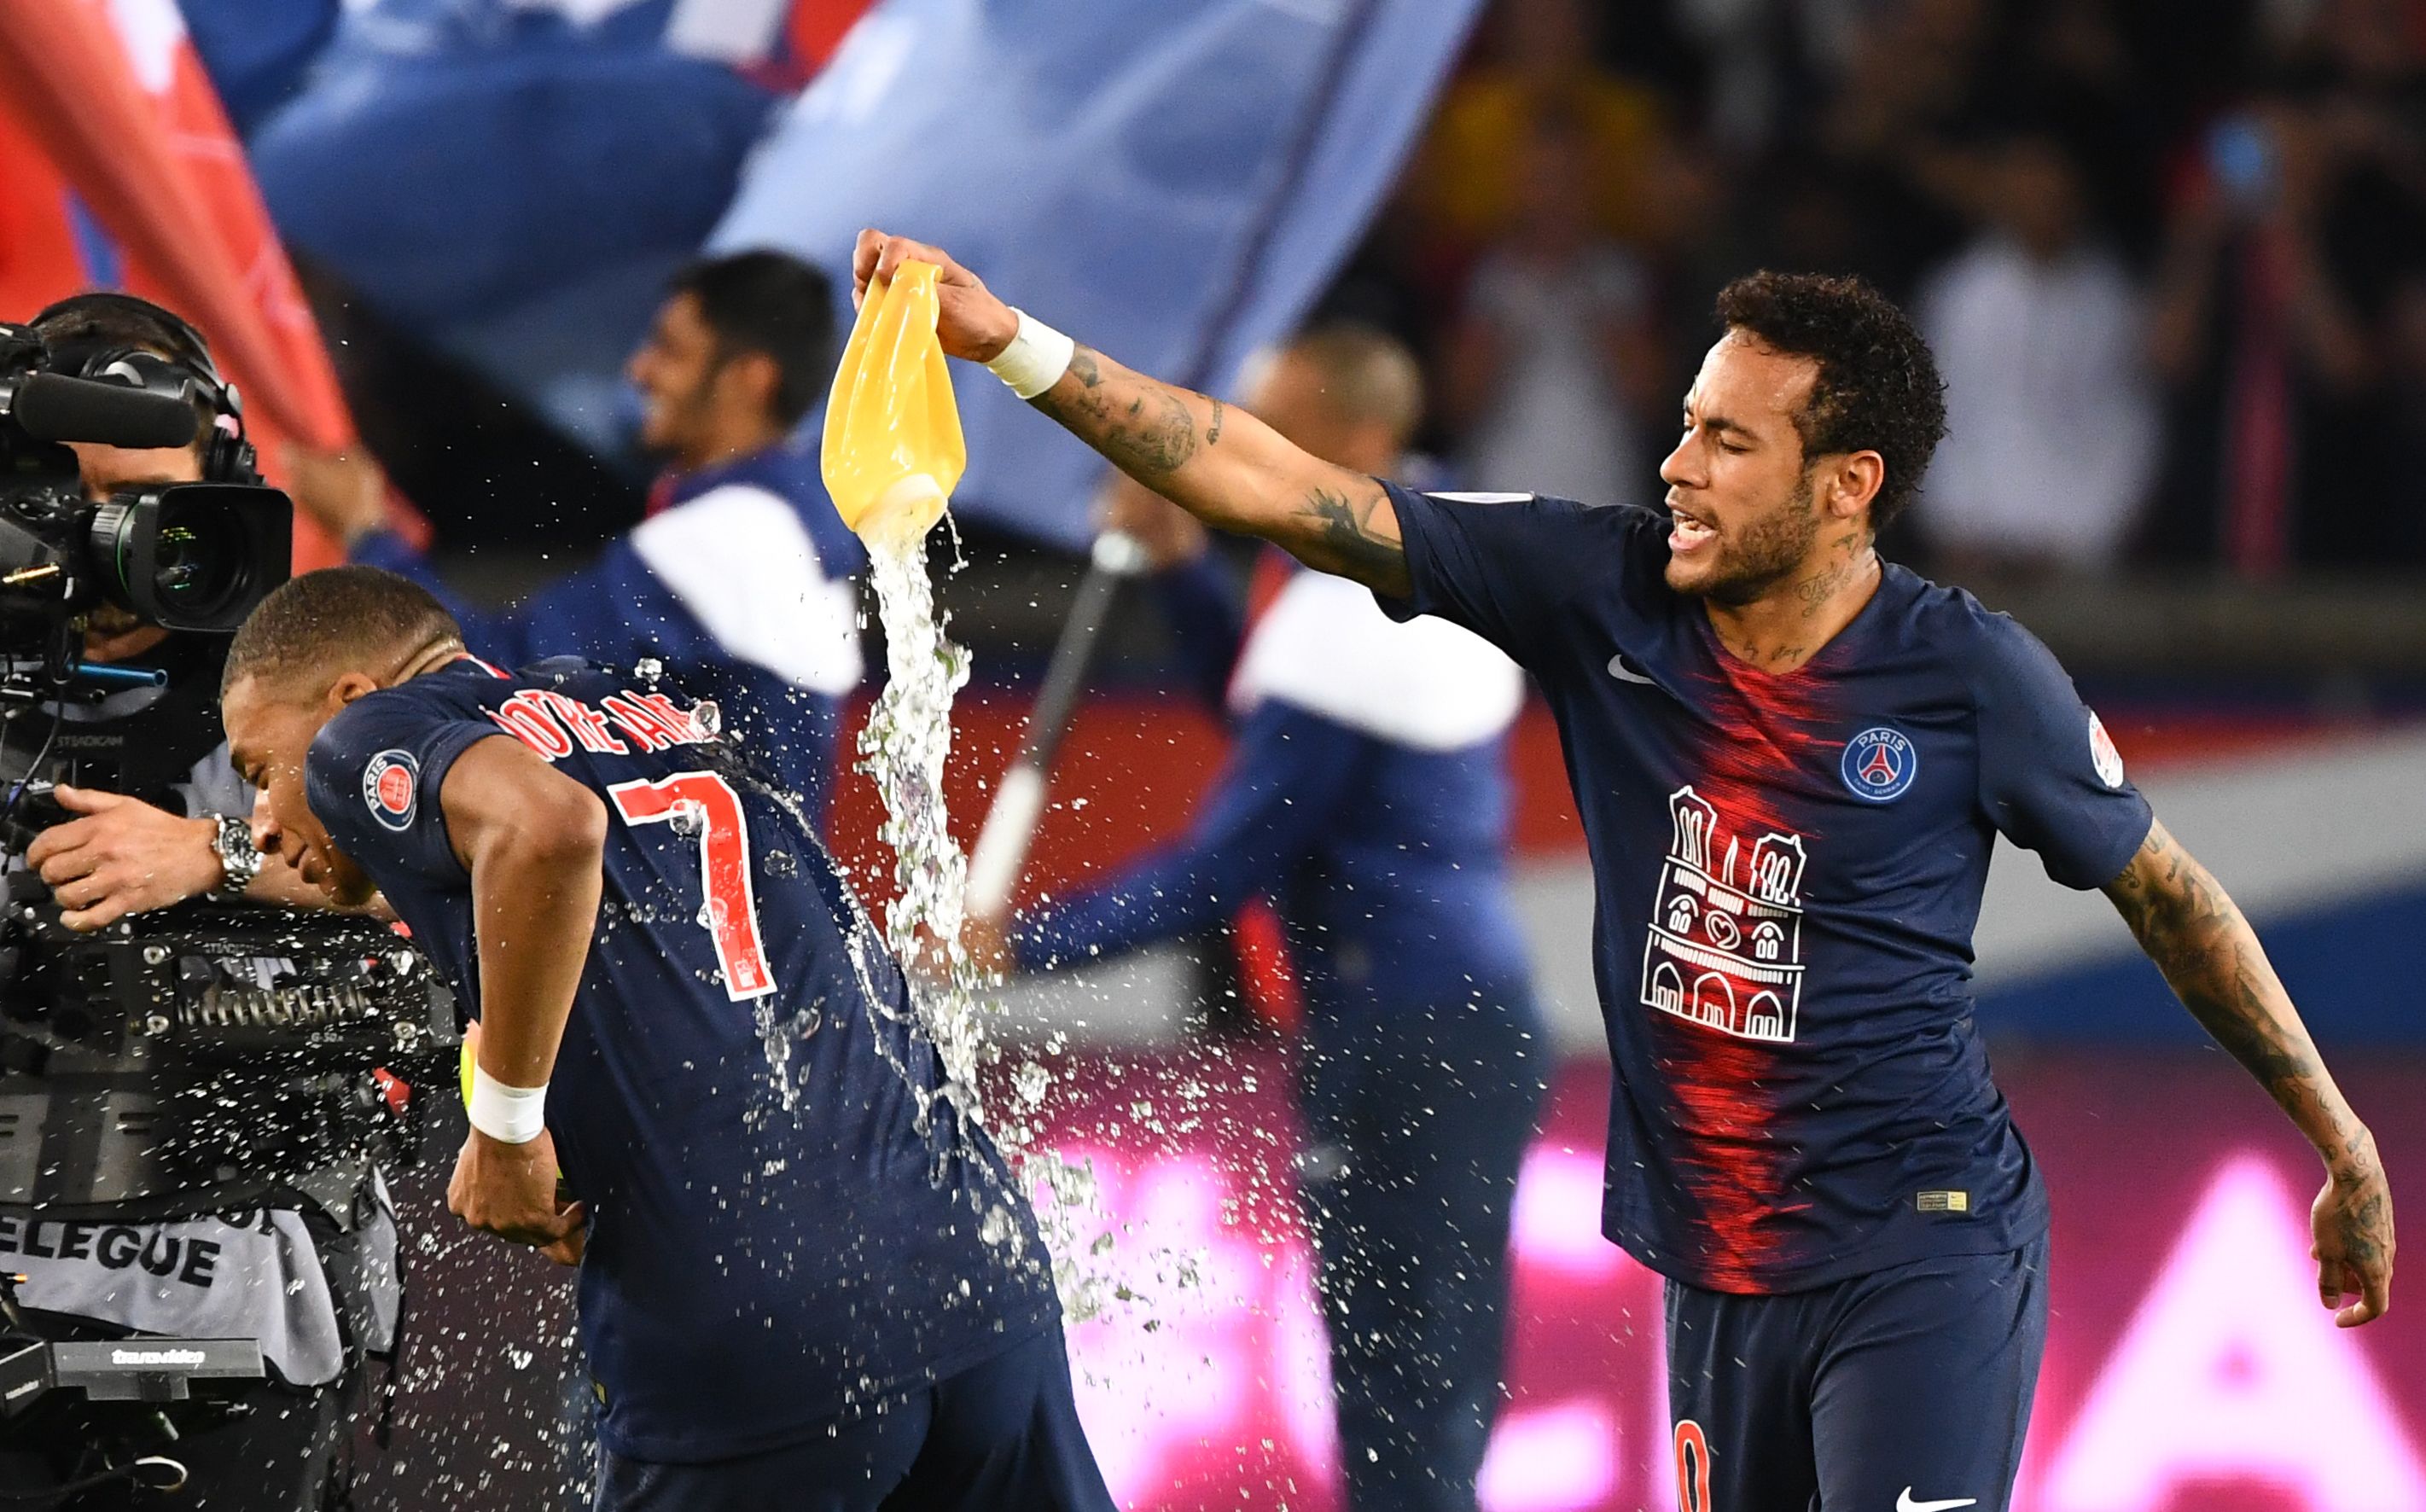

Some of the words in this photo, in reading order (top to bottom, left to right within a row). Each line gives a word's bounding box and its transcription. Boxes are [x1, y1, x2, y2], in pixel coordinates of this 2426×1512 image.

[1858, 731, 1906, 751] PARIS
[367, 757, 388, 811] PARIS
[607, 771, 777, 1002] 7
[111, 1349, 206, 1364] transvideo
